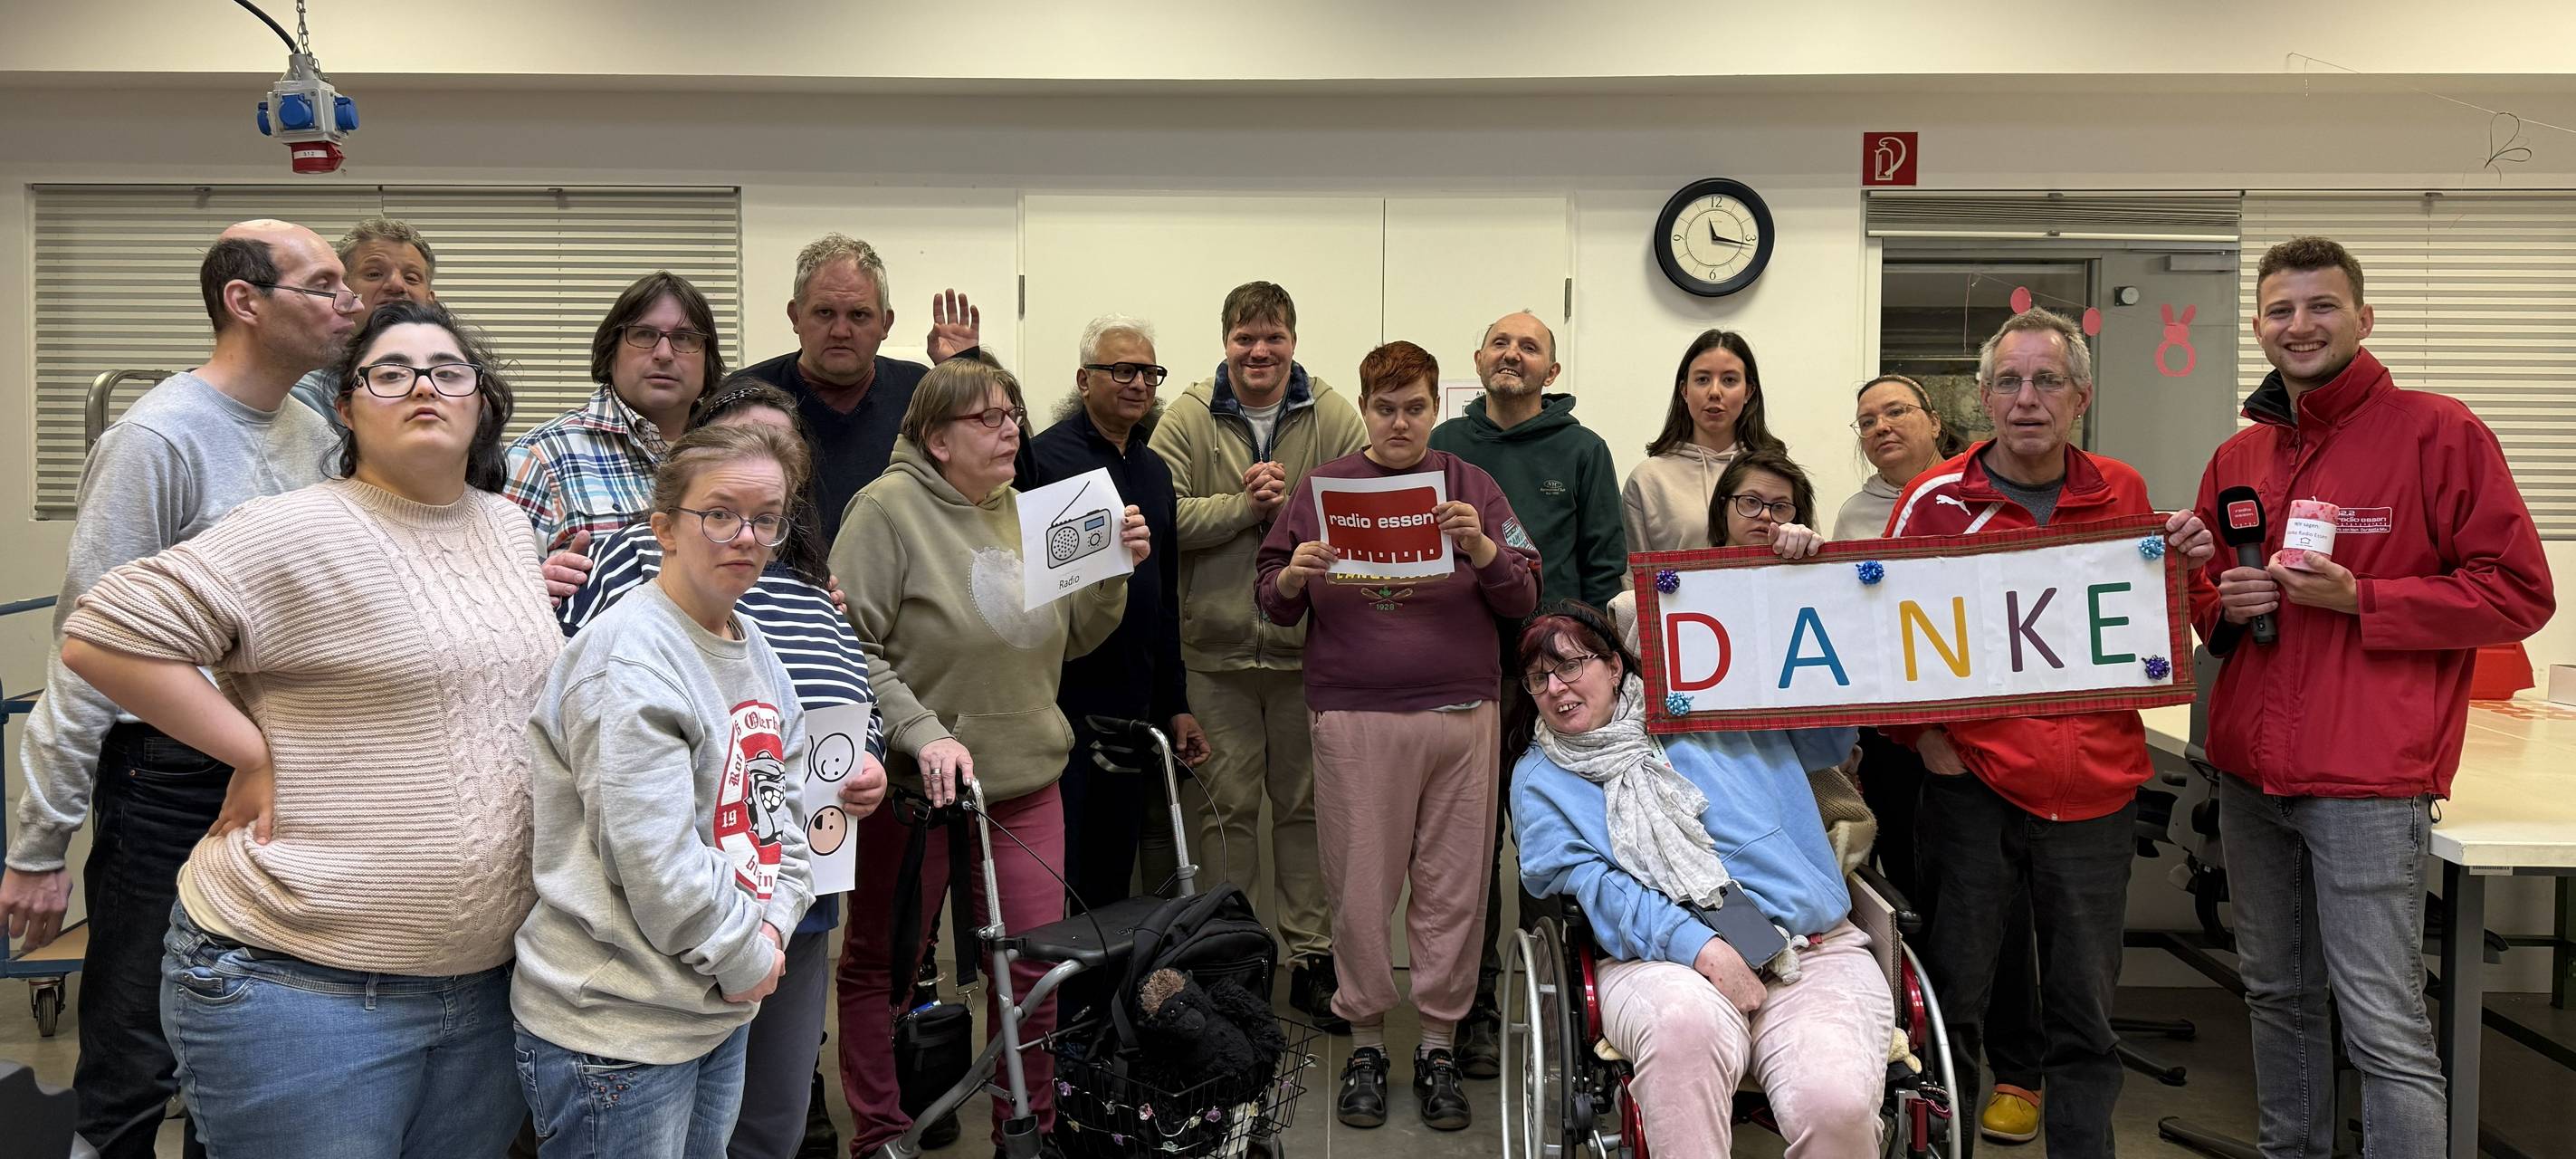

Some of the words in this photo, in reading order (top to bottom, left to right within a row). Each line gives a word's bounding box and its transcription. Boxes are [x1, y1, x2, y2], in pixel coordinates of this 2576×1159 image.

[1710, 196, 1722, 207] 12
[1673, 234, 1684, 242] 9
[1745, 234, 1757, 242] 3
[1709, 268, 1717, 281] 6
[1329, 512, 1371, 529] radio
[1378, 512, 1435, 529] essen
[1059, 575, 1080, 590] Radio
[1666, 581, 2138, 692] DANKE
[721, 809, 738, 829] 19
